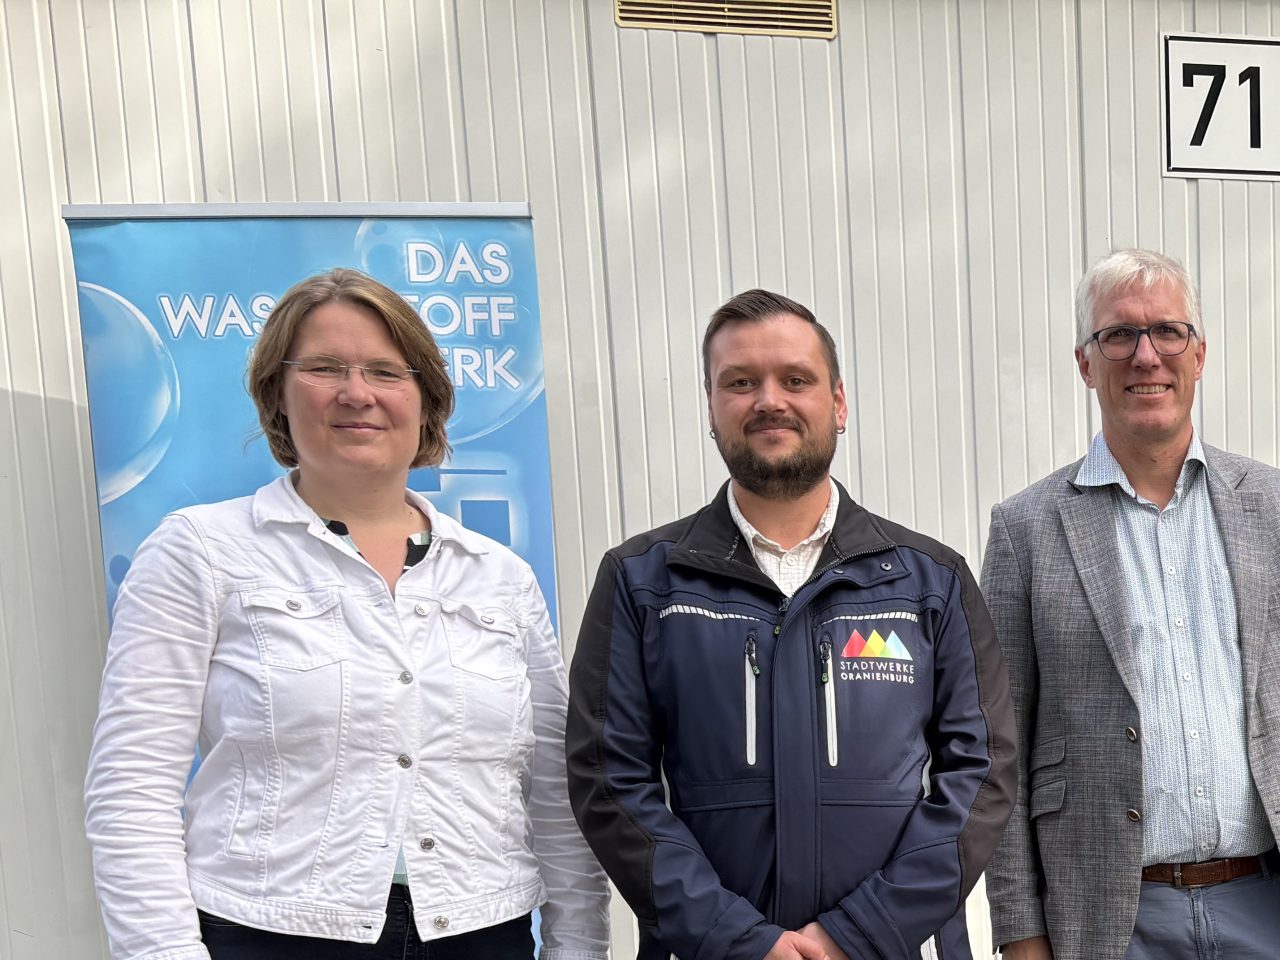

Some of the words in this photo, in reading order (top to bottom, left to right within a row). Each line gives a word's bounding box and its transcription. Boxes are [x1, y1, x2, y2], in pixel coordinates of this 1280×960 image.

[1182, 62, 1261, 149] 71
[407, 241, 511, 284] DAS
[840, 661, 915, 675] STADTWERKE
[840, 672, 915, 684] ORANIENBURG
